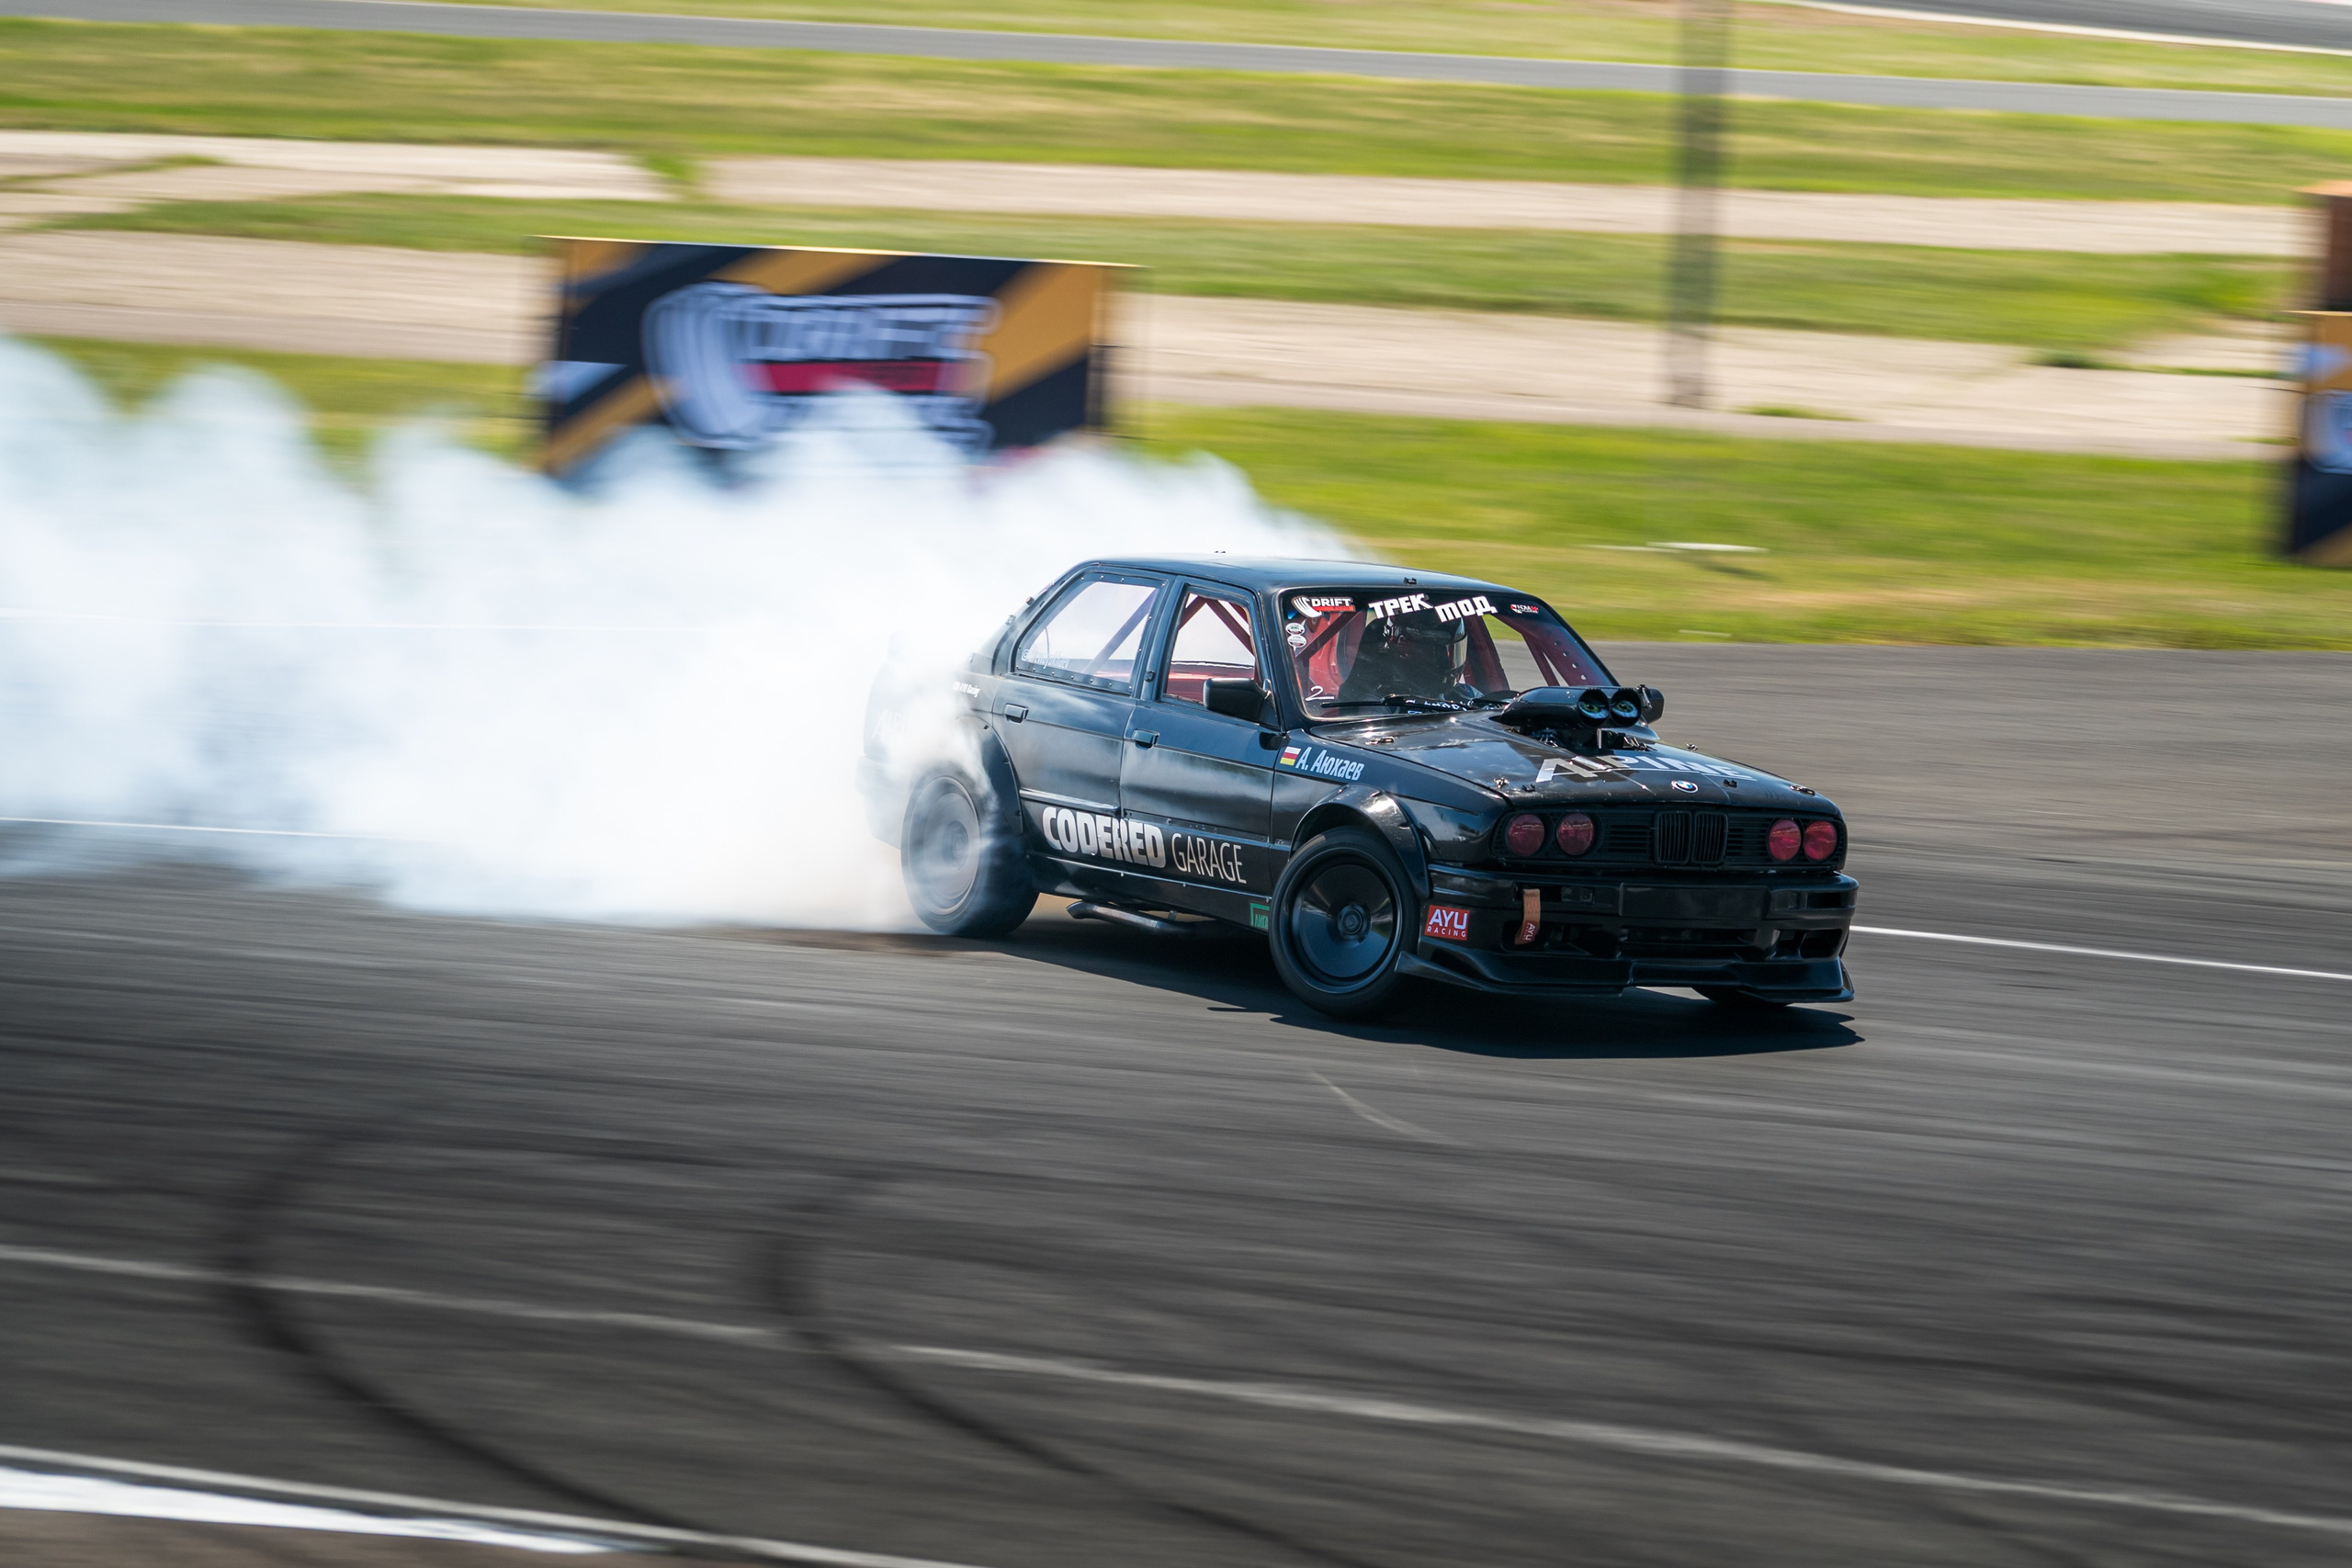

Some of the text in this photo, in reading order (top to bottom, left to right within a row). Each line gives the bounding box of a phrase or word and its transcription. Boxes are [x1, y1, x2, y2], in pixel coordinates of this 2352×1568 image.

[1311, 598, 1351, 607] DRIFT
[1368, 593, 1433, 619] ТРЕК
[1295, 746, 1365, 781] А. Аюхаев
[1535, 755, 1757, 783] ALPINE
[1042, 807, 1248, 884] CODERED GARAGE
[1429, 908, 1468, 930] AYU
[1426, 925, 1466, 938] RACING
[1525, 922, 1536, 941] AYU
